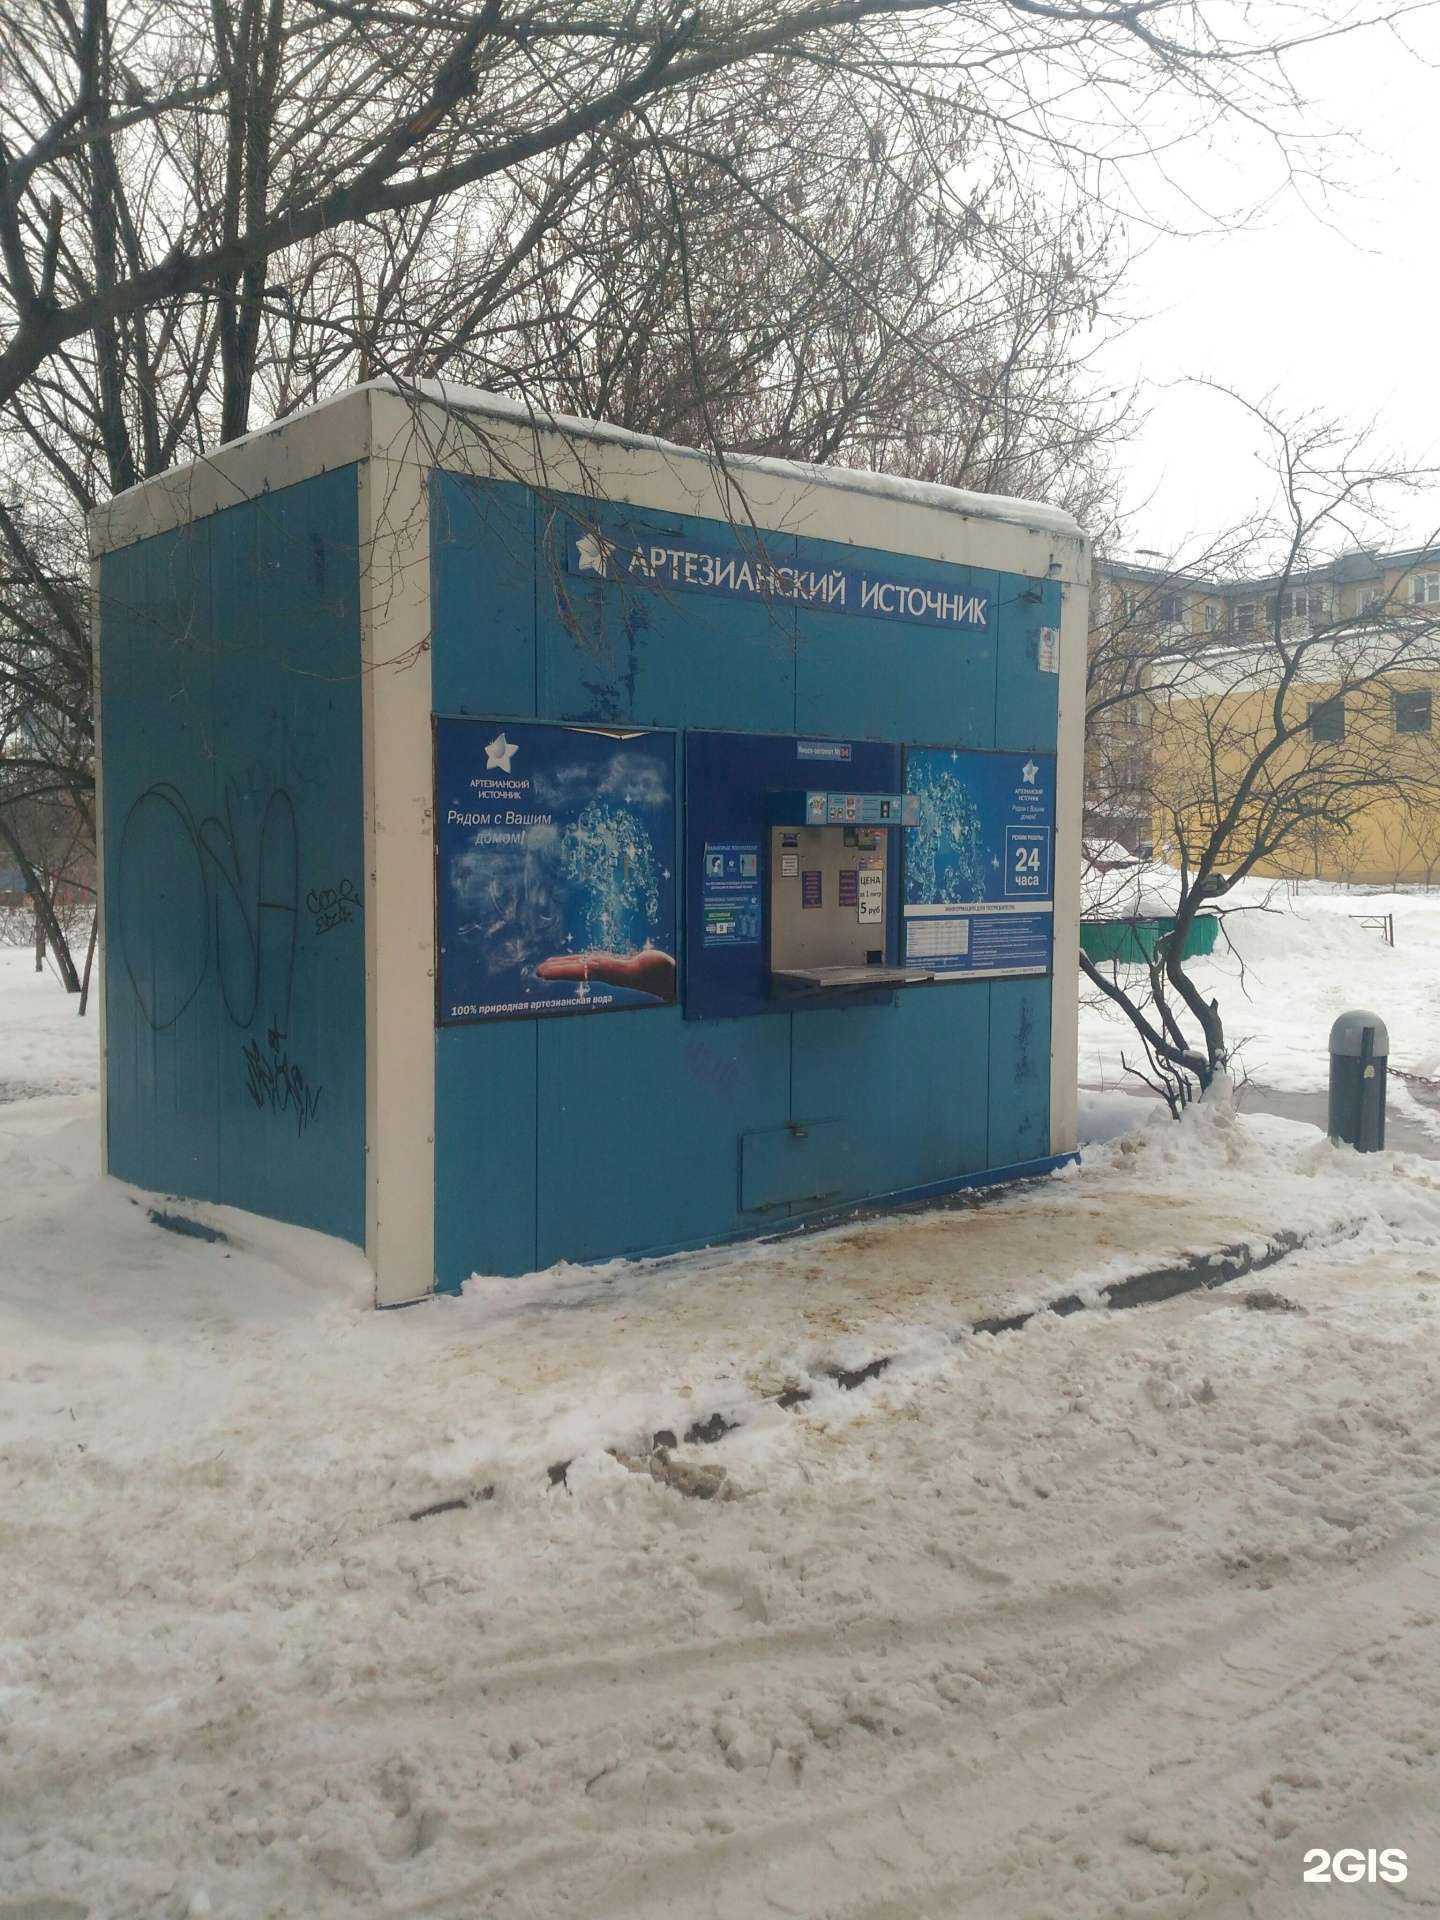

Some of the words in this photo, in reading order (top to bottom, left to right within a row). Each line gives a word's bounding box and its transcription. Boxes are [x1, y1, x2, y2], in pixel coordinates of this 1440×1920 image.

[628, 544, 845, 605] АРТЕЗИАНСКИЙ
[862, 580, 987, 626] ИСТОЧНИК
[470, 779, 530, 789] АРТЕЗИАНСКИЙ
[478, 790, 521, 800] ИСТОЧНИК
[448, 810, 491, 825] Рядом
[494, 814, 501, 825] с
[505, 811, 552, 825] Вашим
[475, 828, 526, 846] домом!
[1015, 847, 1040, 872] 24
[860, 876, 881, 885] ЦЕНА
[1015, 875, 1039, 886] часа
[860, 902, 867, 914] 5
[451, 1005, 477, 1016] 100%
[479, 1001, 529, 1014] природная
[530, 996, 591, 1010] артезианская
[593, 994, 613, 1004] вода
